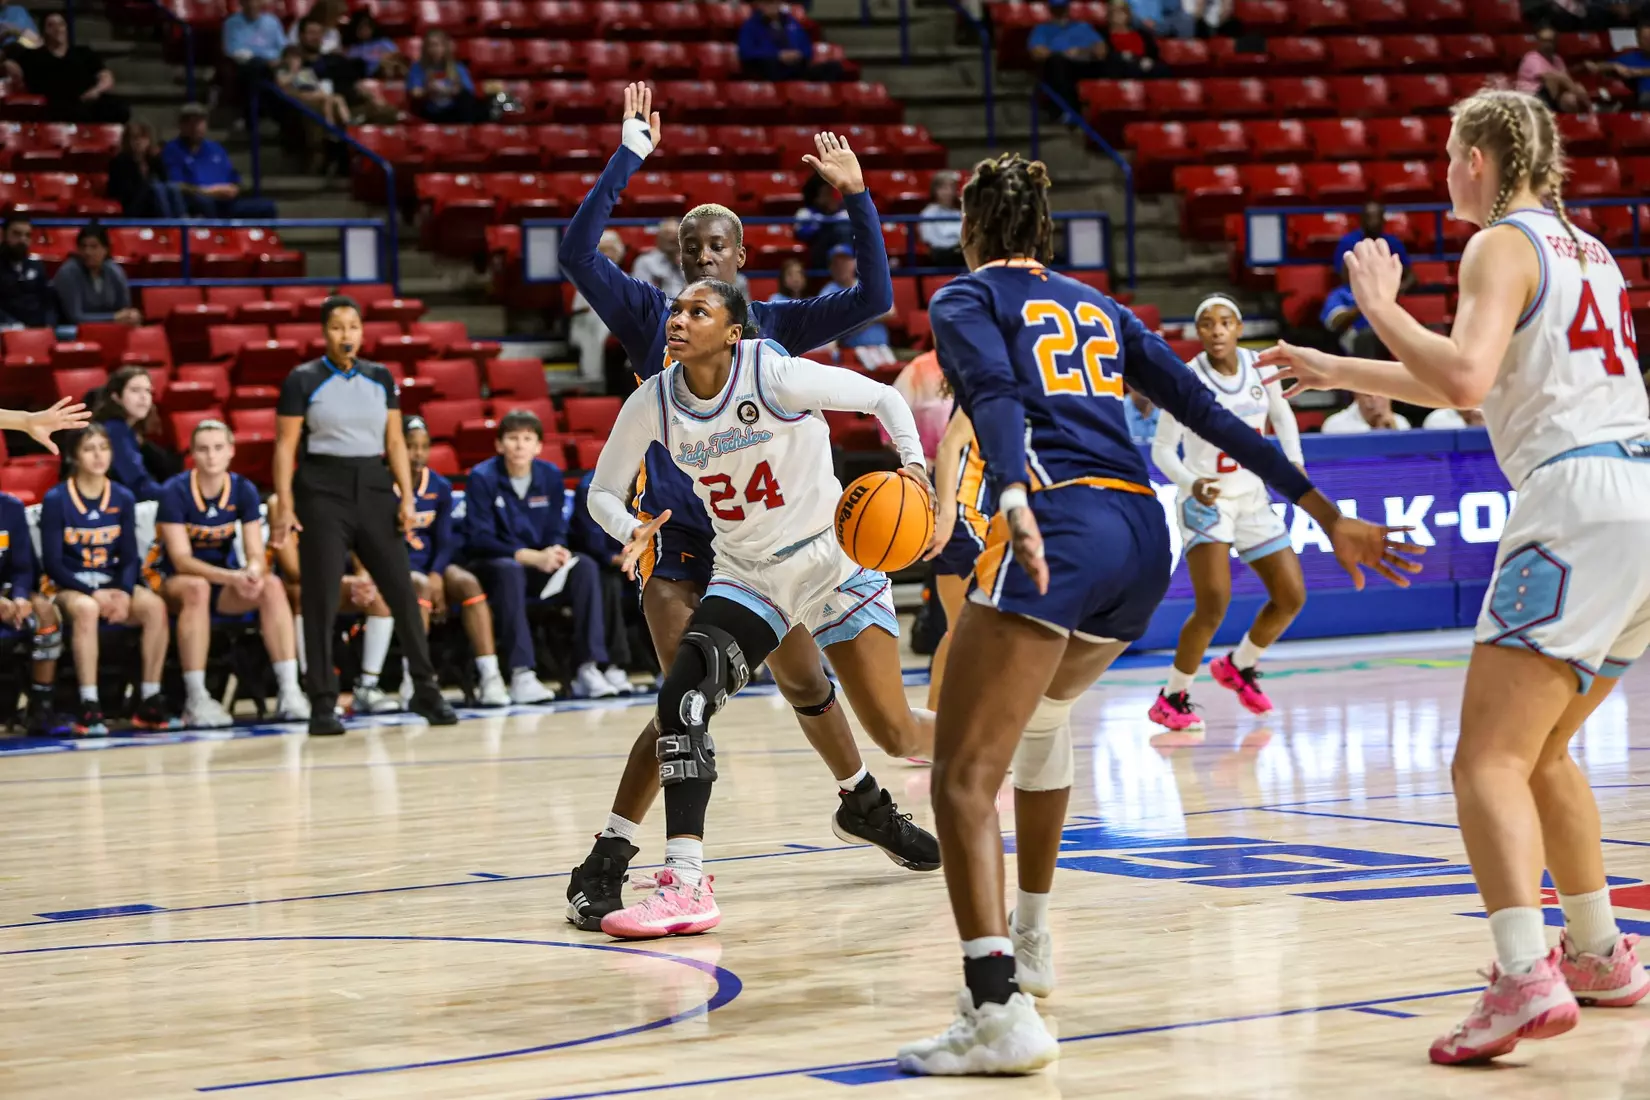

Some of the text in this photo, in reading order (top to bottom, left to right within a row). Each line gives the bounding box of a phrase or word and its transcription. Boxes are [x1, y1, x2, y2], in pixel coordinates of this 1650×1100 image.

[1021, 299, 1124, 401] 22
[675, 426, 774, 470] Lady Techsters
[699, 460, 786, 521] 24
[838, 485, 870, 546] Wilson
[64, 524, 121, 546] UTEP
[1270, 491, 1518, 556] AK-O
